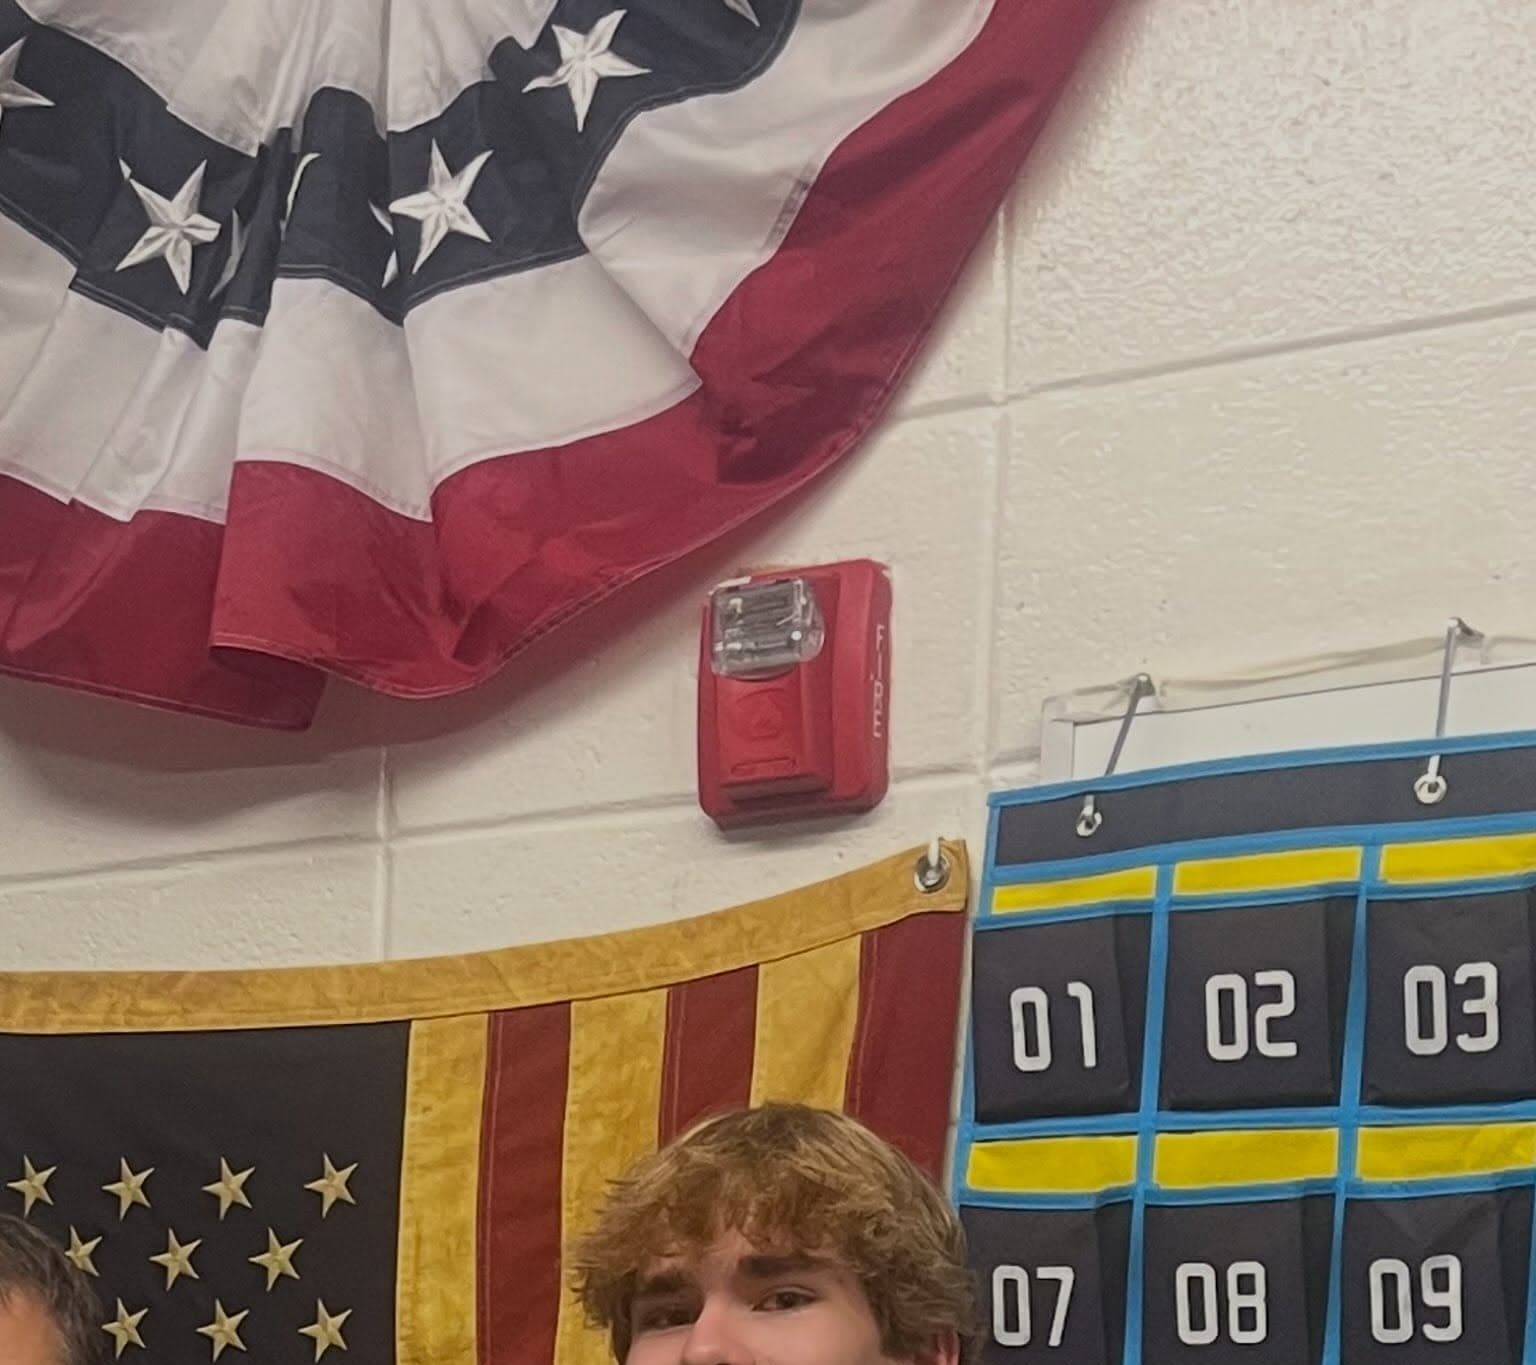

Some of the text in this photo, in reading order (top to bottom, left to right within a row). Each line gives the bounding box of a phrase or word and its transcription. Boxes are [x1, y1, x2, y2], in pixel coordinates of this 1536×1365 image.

[872, 623, 885, 738] FIRE
[1010, 962, 1498, 1071] 01 02 03
[993, 1255, 1461, 1346] 07 08 09
